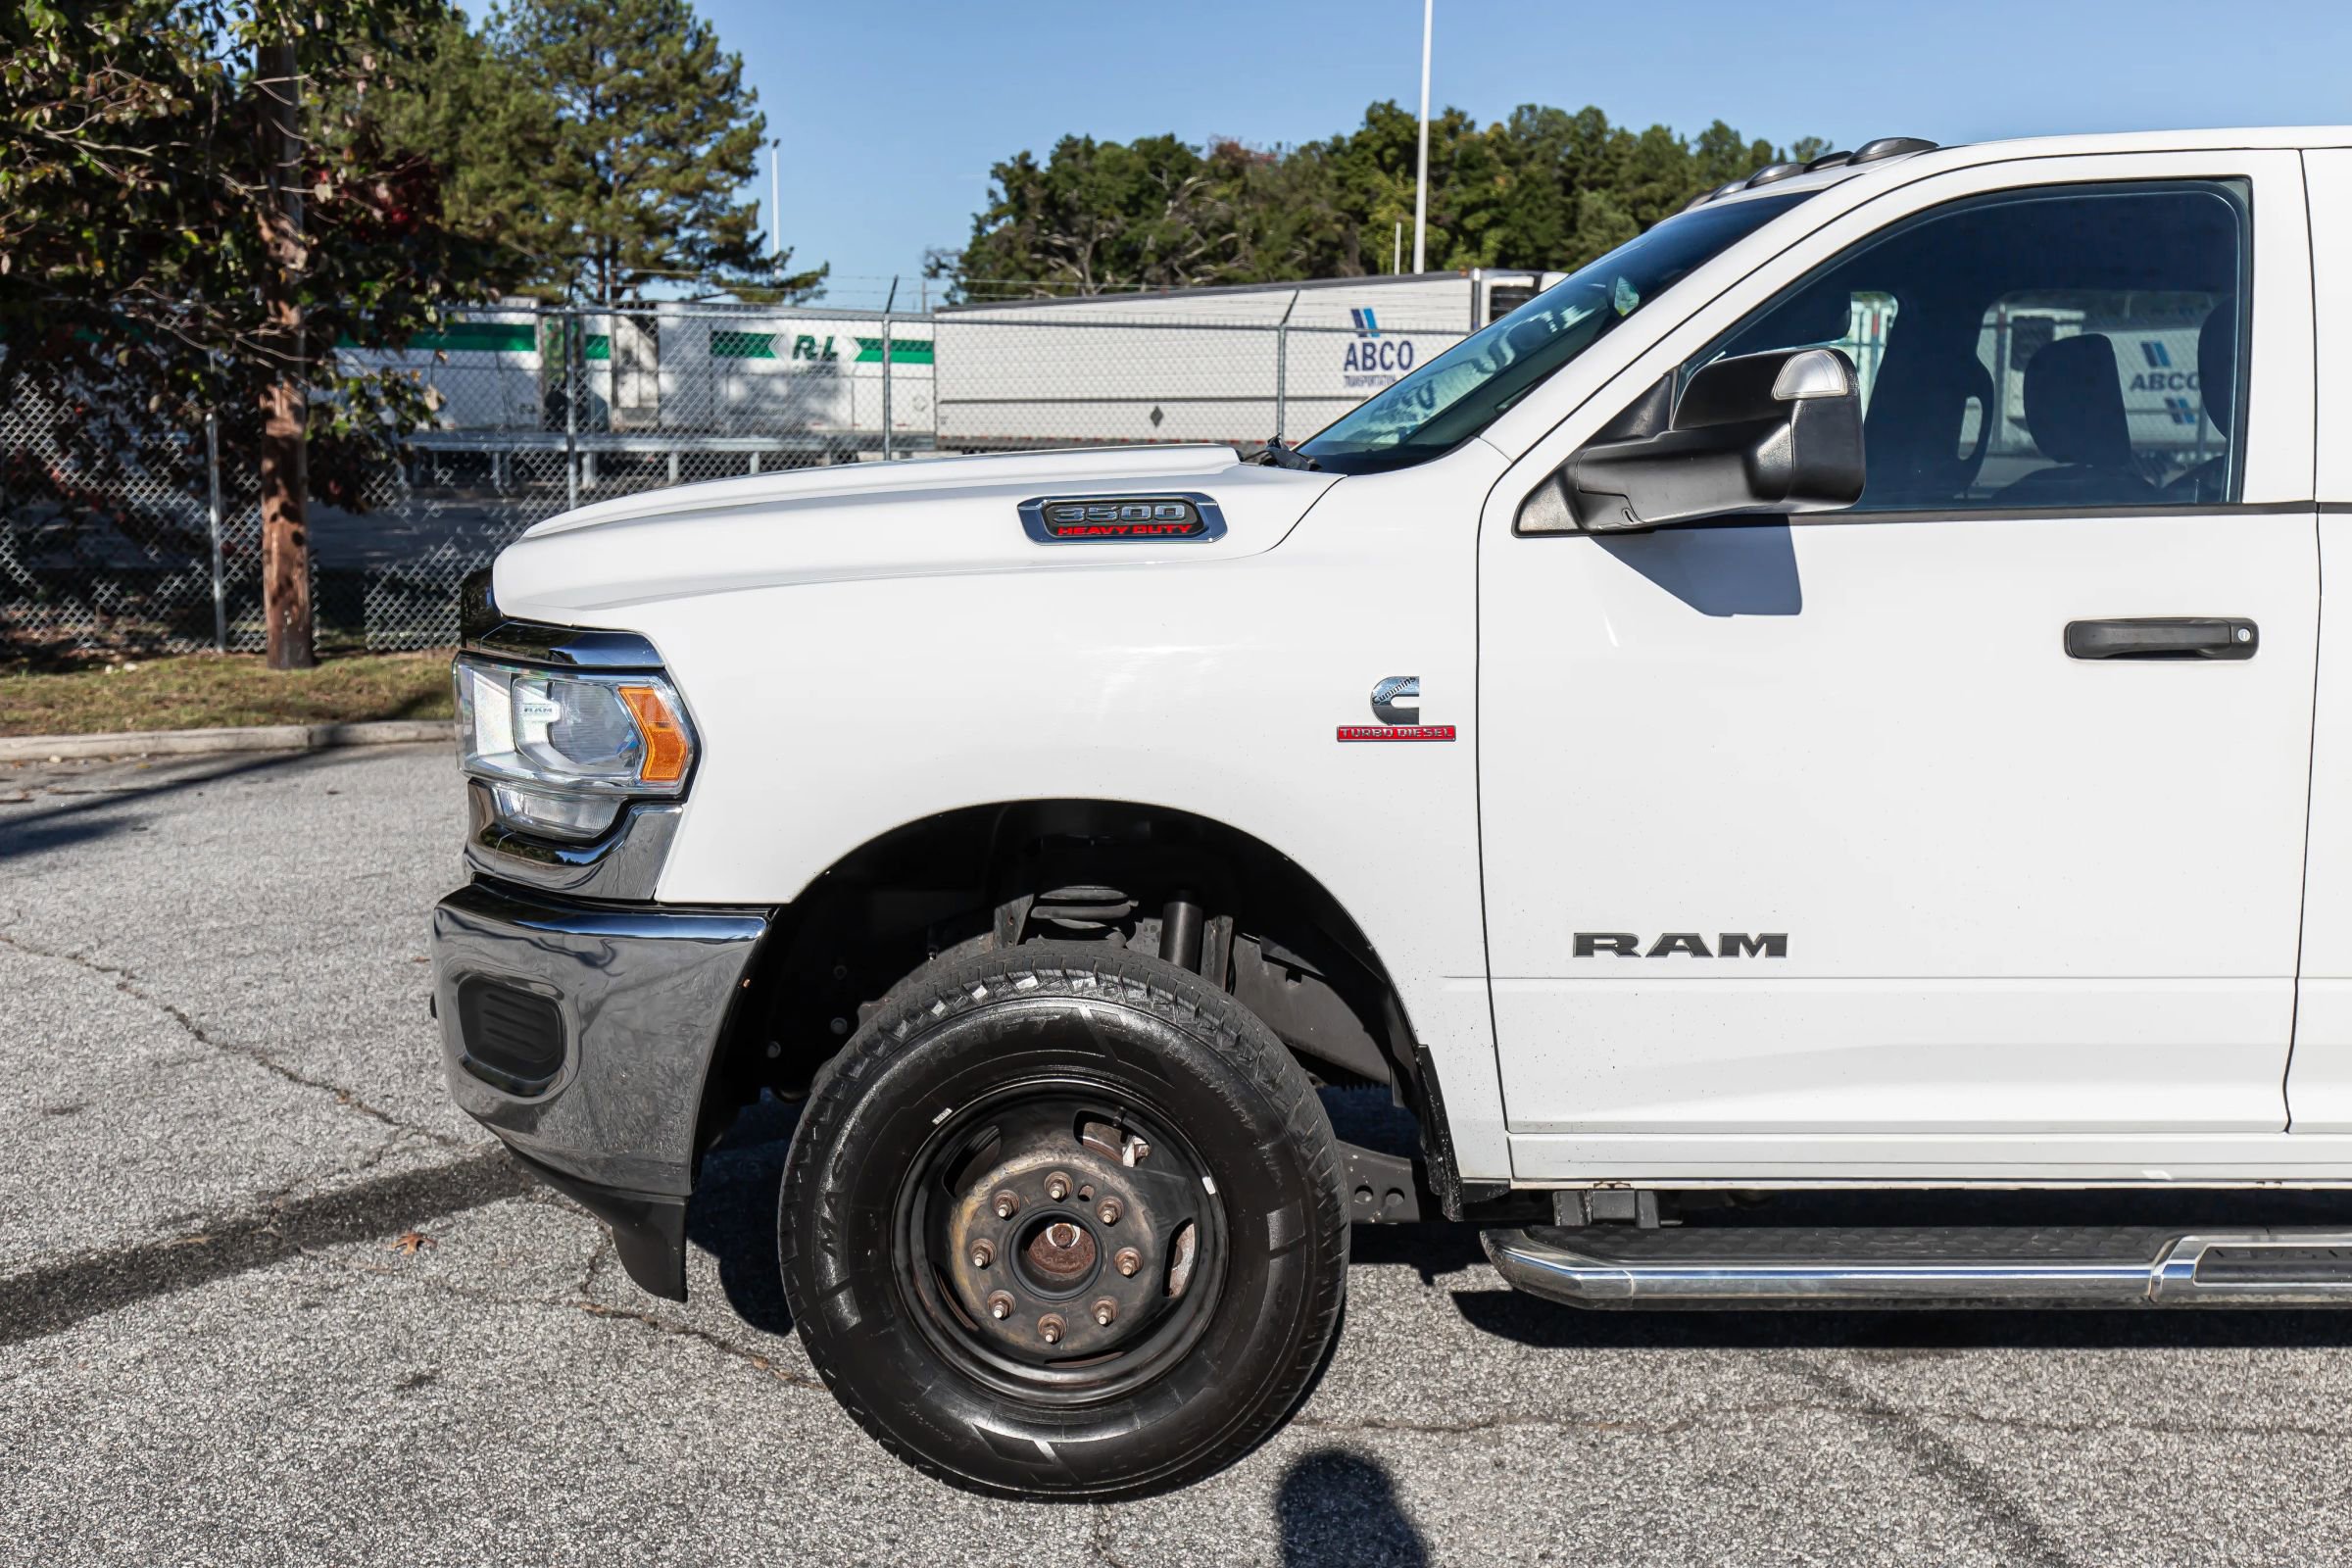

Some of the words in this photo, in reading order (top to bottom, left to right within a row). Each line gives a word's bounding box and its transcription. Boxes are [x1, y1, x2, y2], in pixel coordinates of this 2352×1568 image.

[1344, 340, 1413, 370] ABCO
[1053, 504, 1187, 523] 3500
[1057, 526, 1131, 536] HEAVY
[1132, 524, 1193, 534] DUTY
[1372, 676, 1416, 705] Cummins
[1340, 728, 1394, 738] TURBO
[1396, 728, 1452, 738] DIESEL
[1573, 932, 1788, 958] RAM
